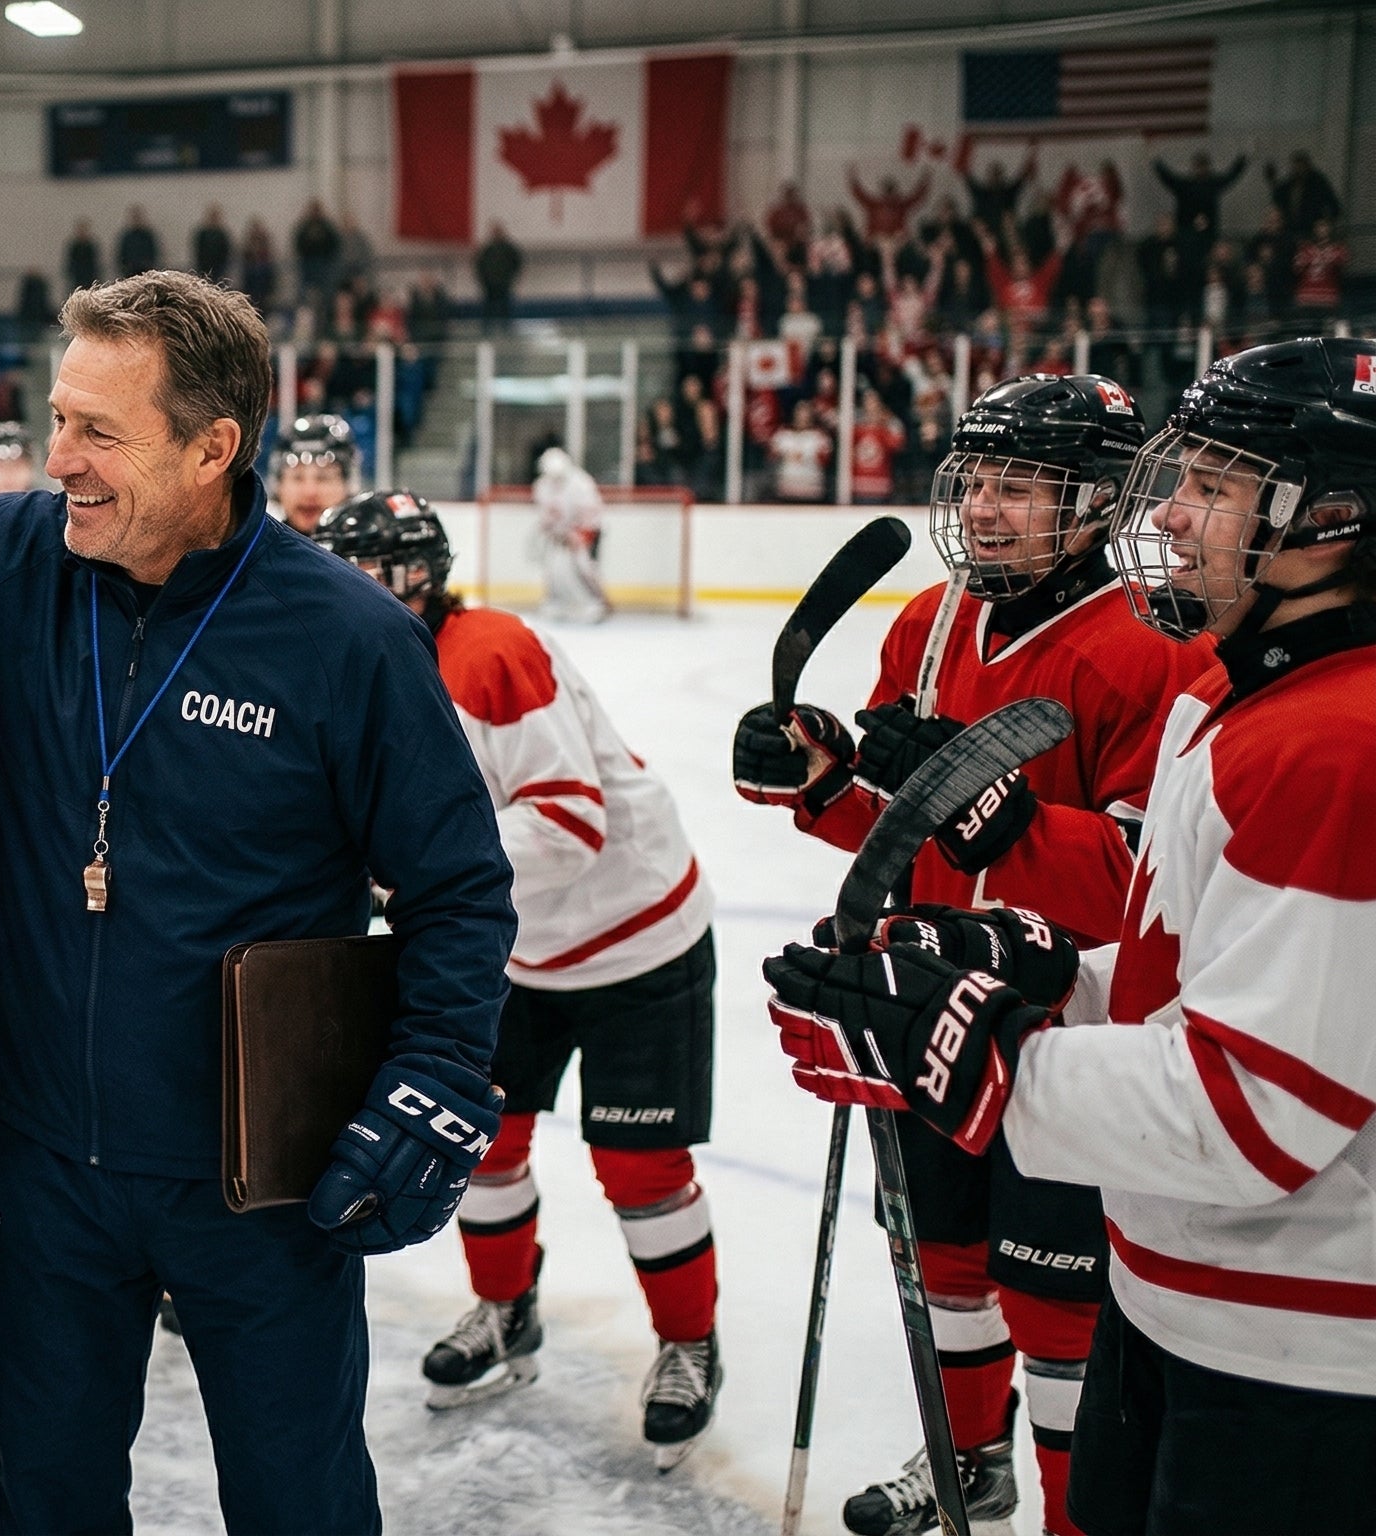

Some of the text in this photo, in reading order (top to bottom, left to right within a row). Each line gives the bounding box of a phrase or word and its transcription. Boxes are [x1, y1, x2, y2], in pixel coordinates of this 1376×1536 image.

[181, 690, 276, 738] COACH
[388, 1082, 494, 1160] CCM
[590, 1105, 675, 1124] BAUER
[999, 1239, 1096, 1272] BAUER
